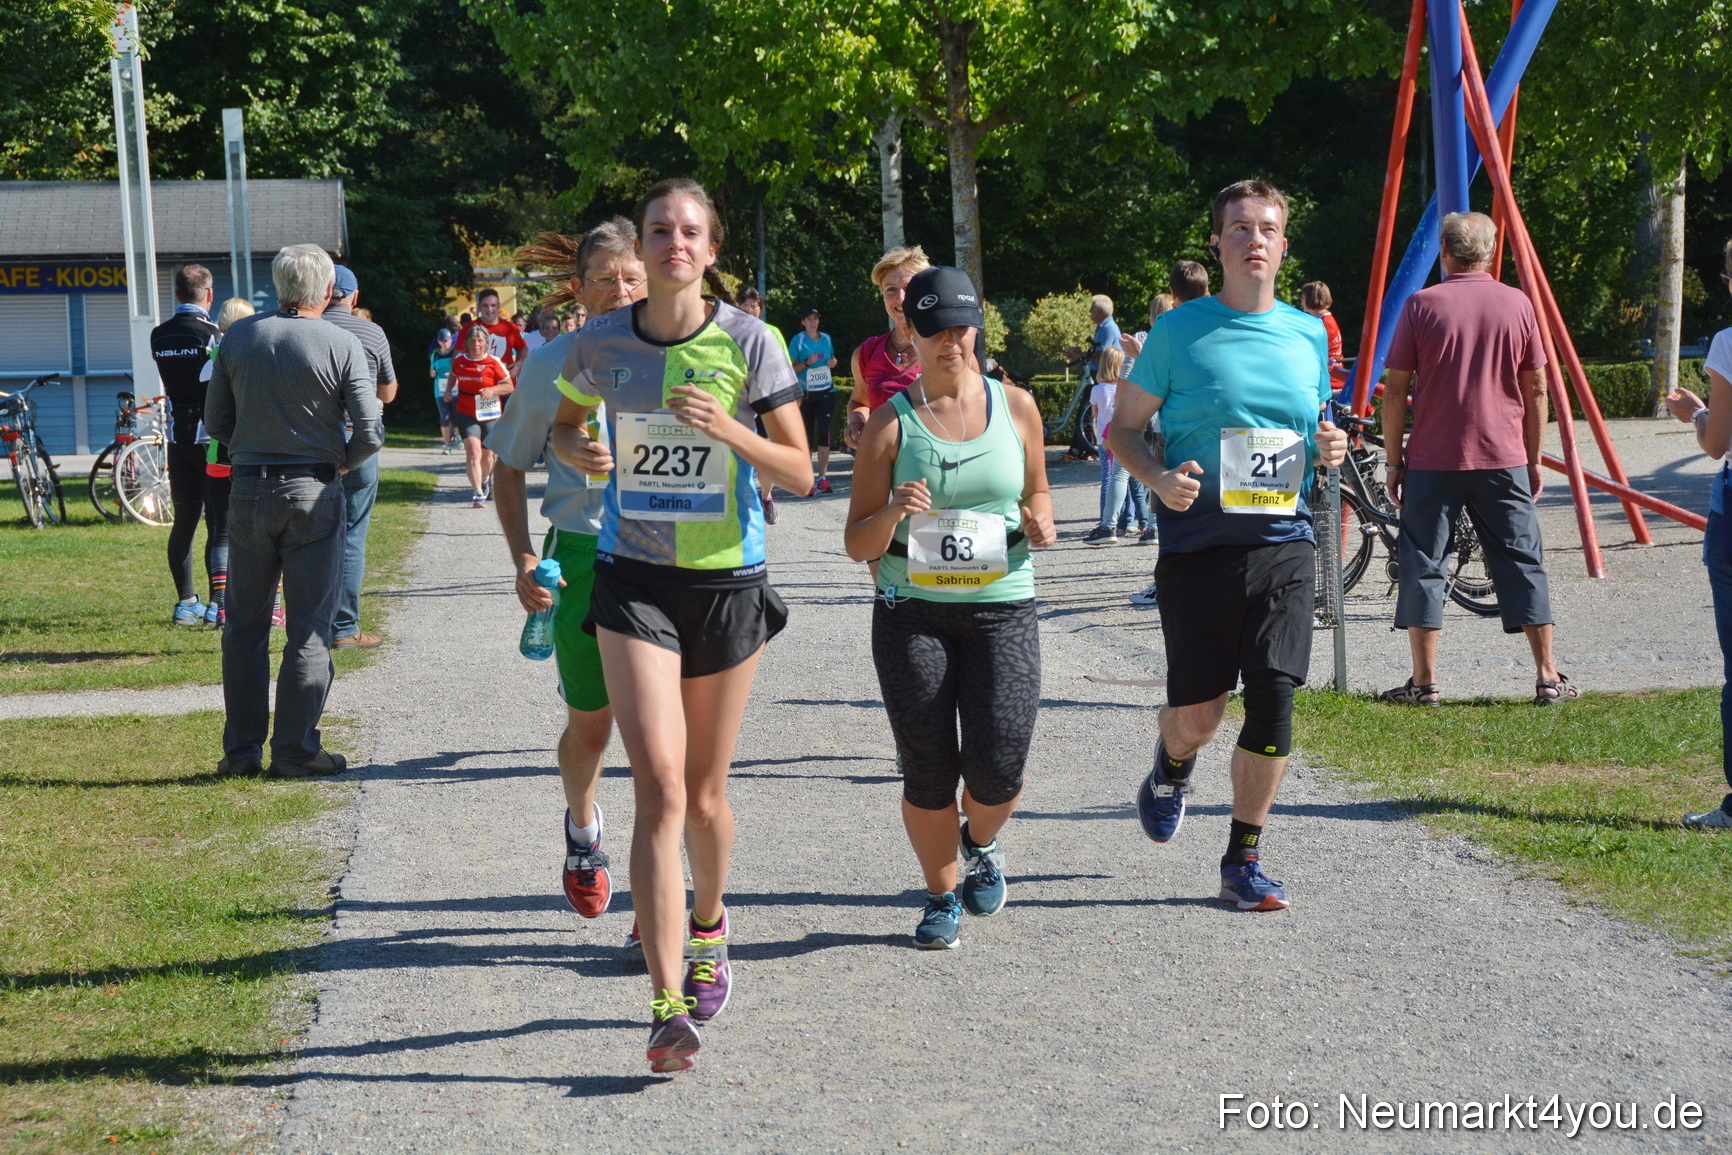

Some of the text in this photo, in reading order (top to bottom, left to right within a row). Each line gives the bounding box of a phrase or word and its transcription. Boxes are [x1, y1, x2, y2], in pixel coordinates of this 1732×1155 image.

[56, 266, 128, 287] KIOSK
[647, 424, 696, 436] BOCK
[1247, 436, 1284, 446] BOCK
[632, 444, 711, 477] 2237
[1251, 453, 1277, 478] 21
[649, 495, 692, 510] Carina
[1251, 493, 1280, 505] Franz
[937, 518, 978, 530] BOCK
[940, 535, 974, 562] 63
[936, 575, 980, 585] Sabrina
